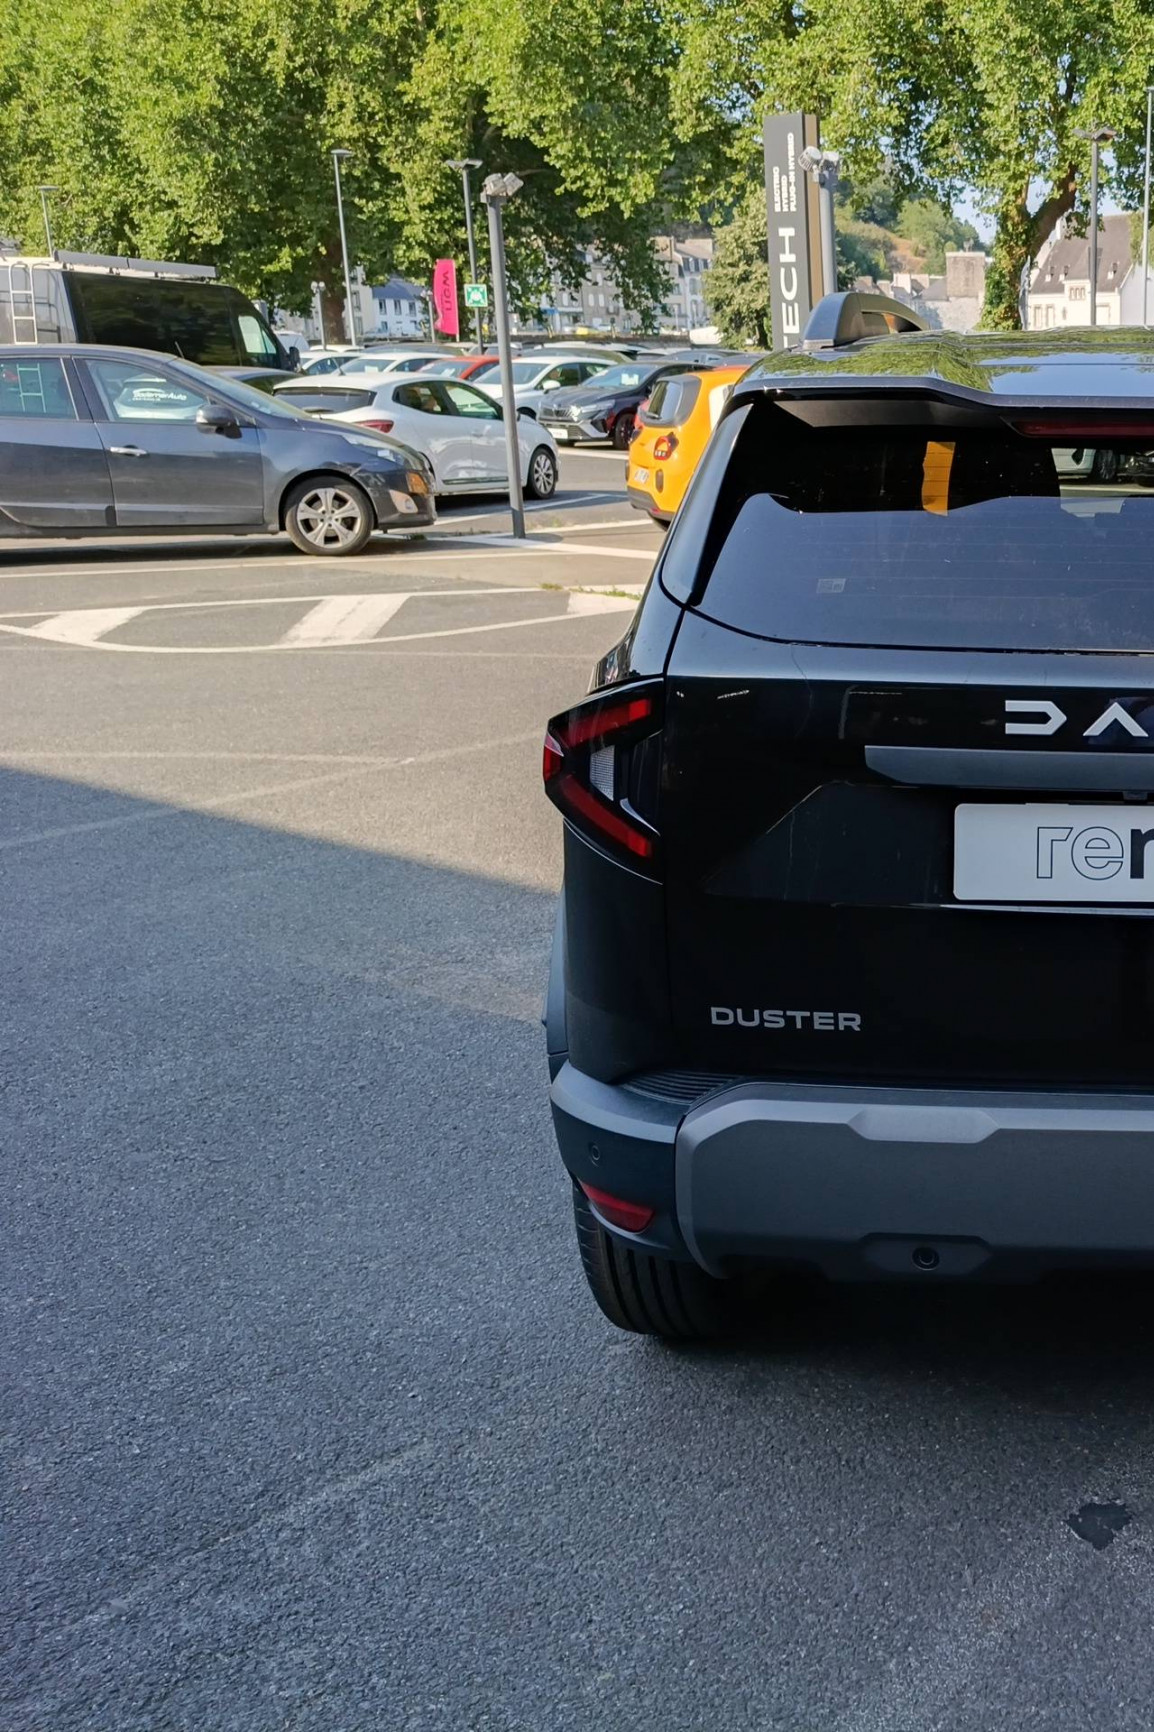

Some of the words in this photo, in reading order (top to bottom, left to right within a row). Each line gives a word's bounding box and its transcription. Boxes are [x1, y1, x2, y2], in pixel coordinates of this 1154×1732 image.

[787, 132, 795, 170] HYBRID
[788, 171, 797, 212] PLUG-IN
[709, 1006, 863, 1032] DUSTER
